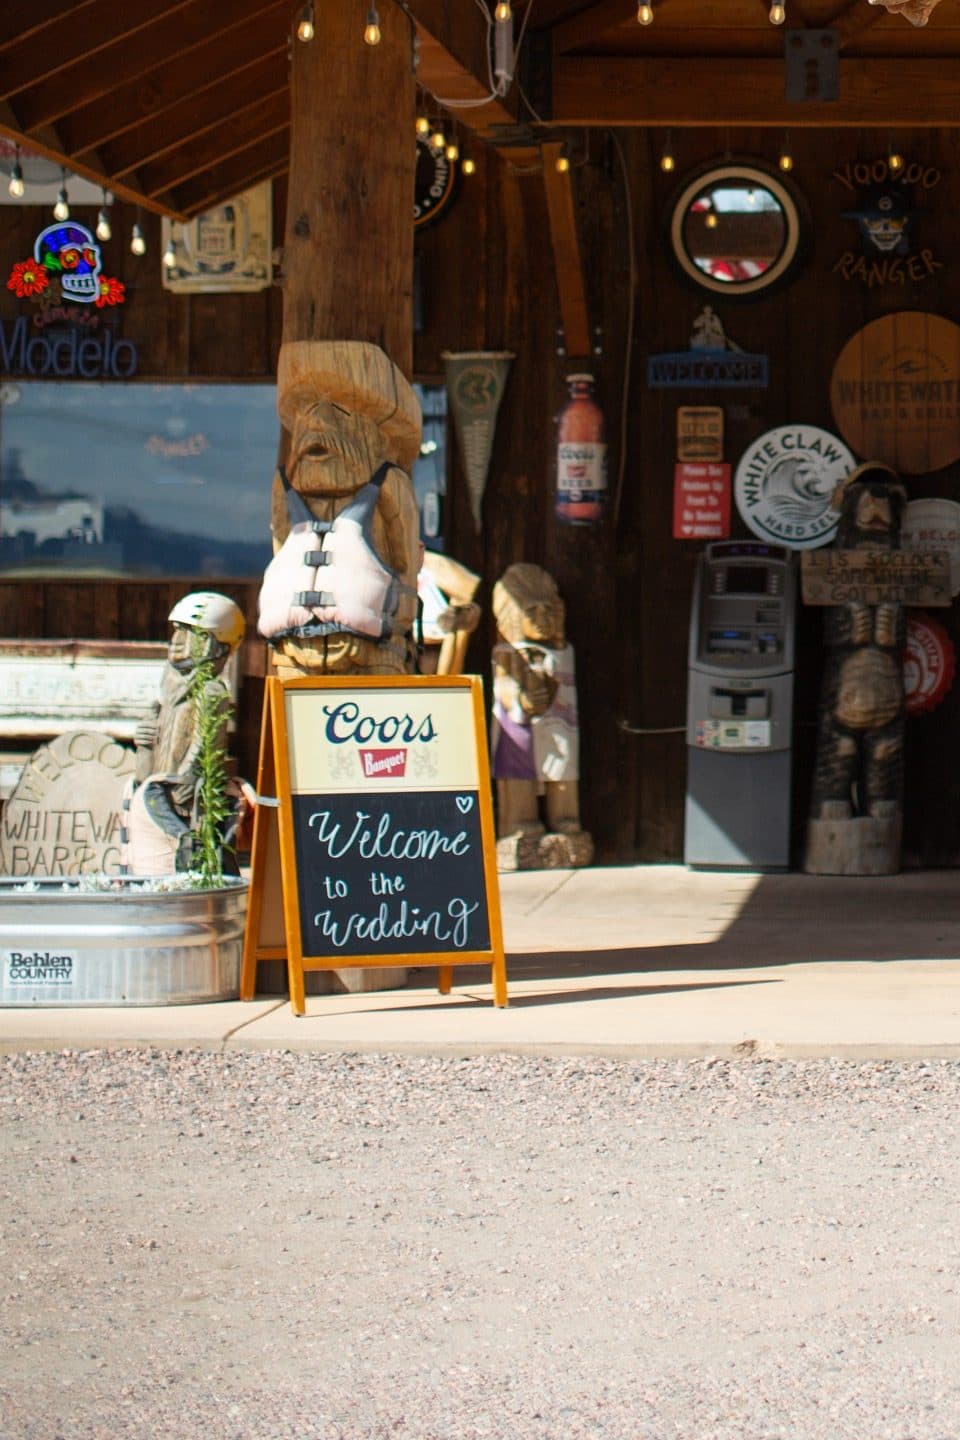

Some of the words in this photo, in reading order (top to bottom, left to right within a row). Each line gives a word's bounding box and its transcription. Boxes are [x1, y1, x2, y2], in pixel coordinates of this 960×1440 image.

[832, 249, 944, 288] RANGER
[0, 315, 138, 377] Modelo
[654, 361, 760, 381] WELCOME
[743, 441, 779, 508] WHITE
[780, 433, 843, 464] CLAW
[764, 515, 805, 537] HARD
[322, 702, 438, 744] Coors
[363, 750, 405, 776] Banquet
[4, 810, 124, 843] WHITEWA
[308, 811, 471, 860] Welcome
[12, 846, 64, 877] BAR
[323, 875, 349, 900] to
[368, 872, 405, 896] the
[10, 952, 73, 968] Behlen
[10, 968, 73, 980] COUNTRY
